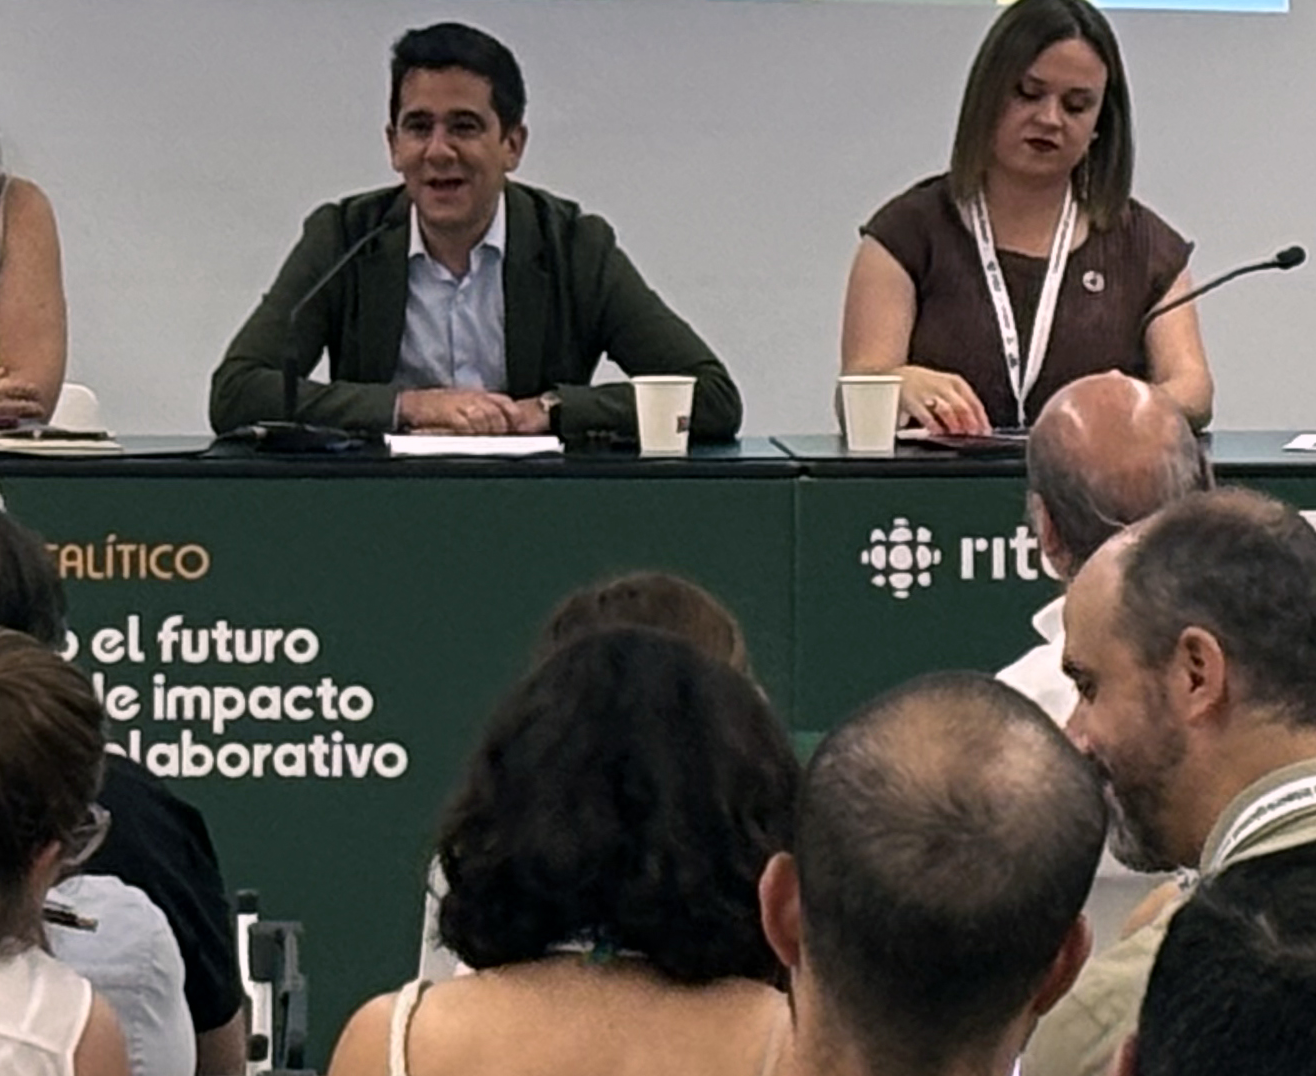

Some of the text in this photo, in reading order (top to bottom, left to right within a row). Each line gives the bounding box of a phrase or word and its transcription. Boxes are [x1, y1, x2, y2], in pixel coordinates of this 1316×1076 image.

[960, 526, 1065, 581] rit
[91, 615, 145, 663] el
[157, 615, 320, 663] futuro
[153, 674, 374, 734] impacto
